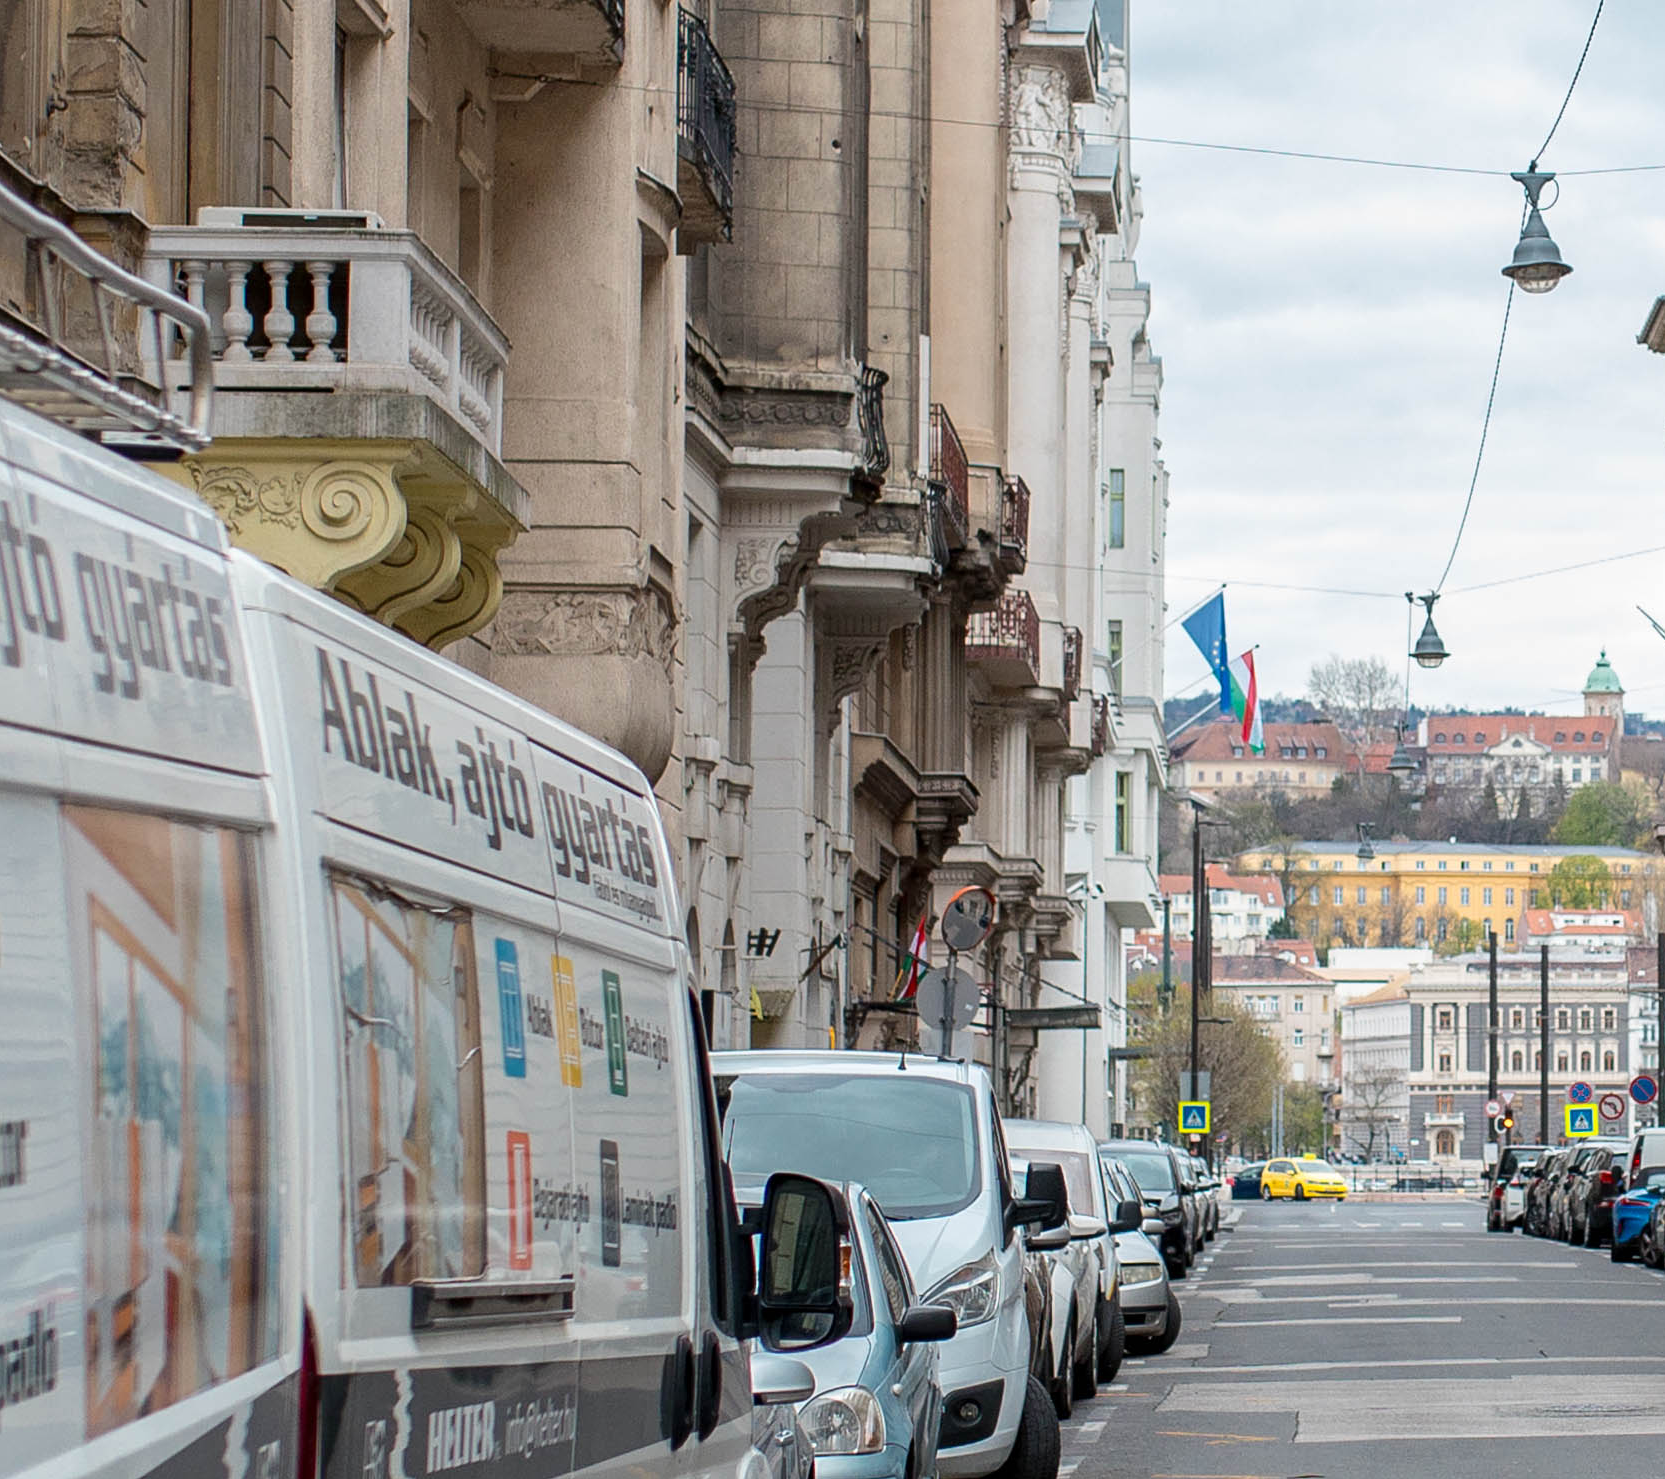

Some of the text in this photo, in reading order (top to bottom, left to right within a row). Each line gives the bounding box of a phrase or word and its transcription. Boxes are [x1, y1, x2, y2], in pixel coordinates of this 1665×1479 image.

[75, 532, 233, 700] gyártás
[316, 646, 659, 887] Ablak, ajtó gyártás
[426, 1401, 495, 1474] HELTER
